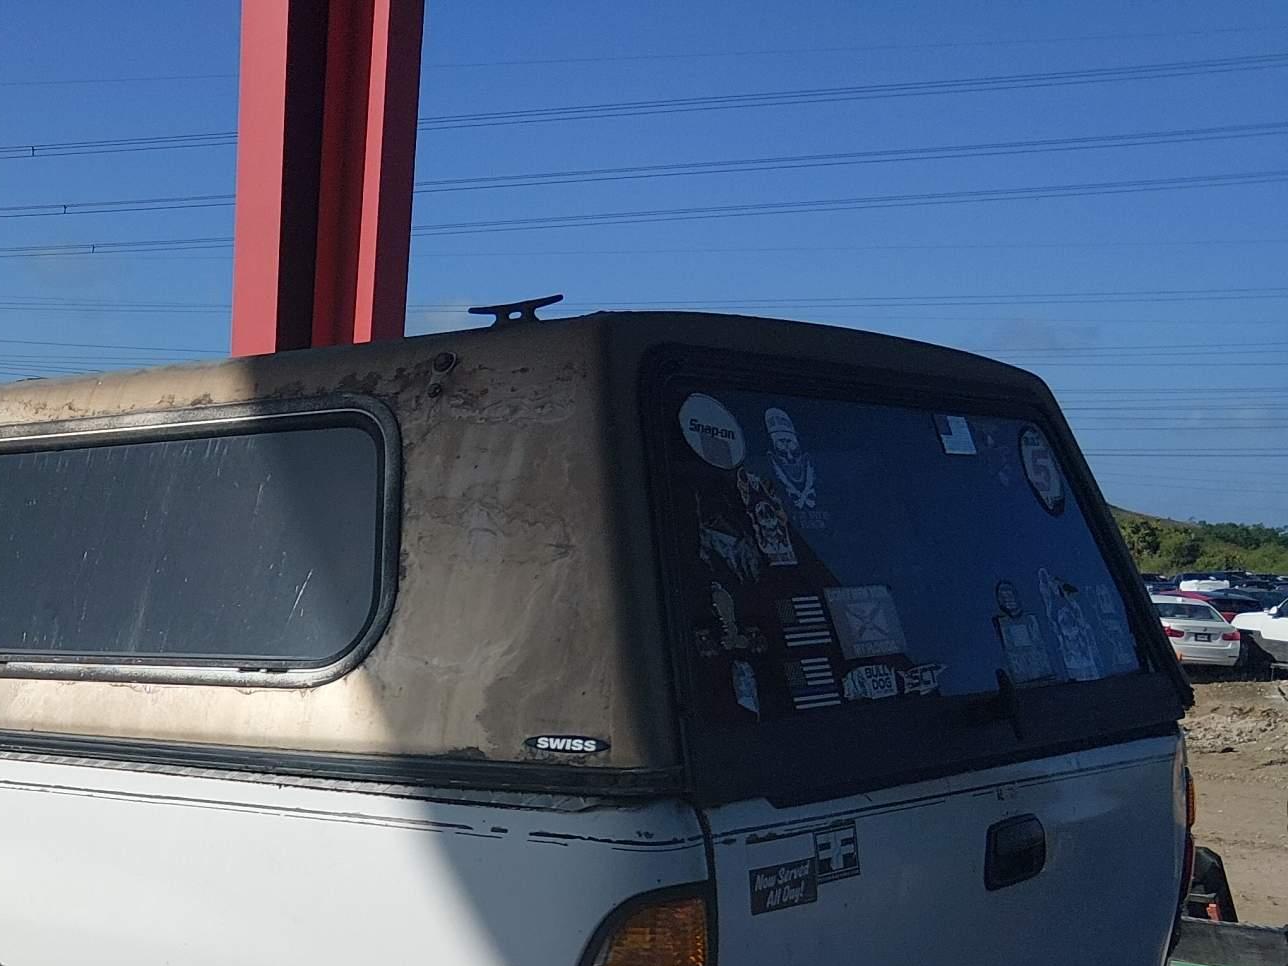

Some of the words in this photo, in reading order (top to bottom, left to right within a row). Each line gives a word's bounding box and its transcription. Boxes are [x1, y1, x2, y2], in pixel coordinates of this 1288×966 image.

[688, 418, 735, 441] Snap-on
[872, 676, 893, 690] DOG
[536, 736, 597, 752] SWISS
[755, 872, 777, 892] Now
[777, 860, 810, 884] Served
[766, 887, 781, 908] All
[782, 879, 805, 903] Day!
